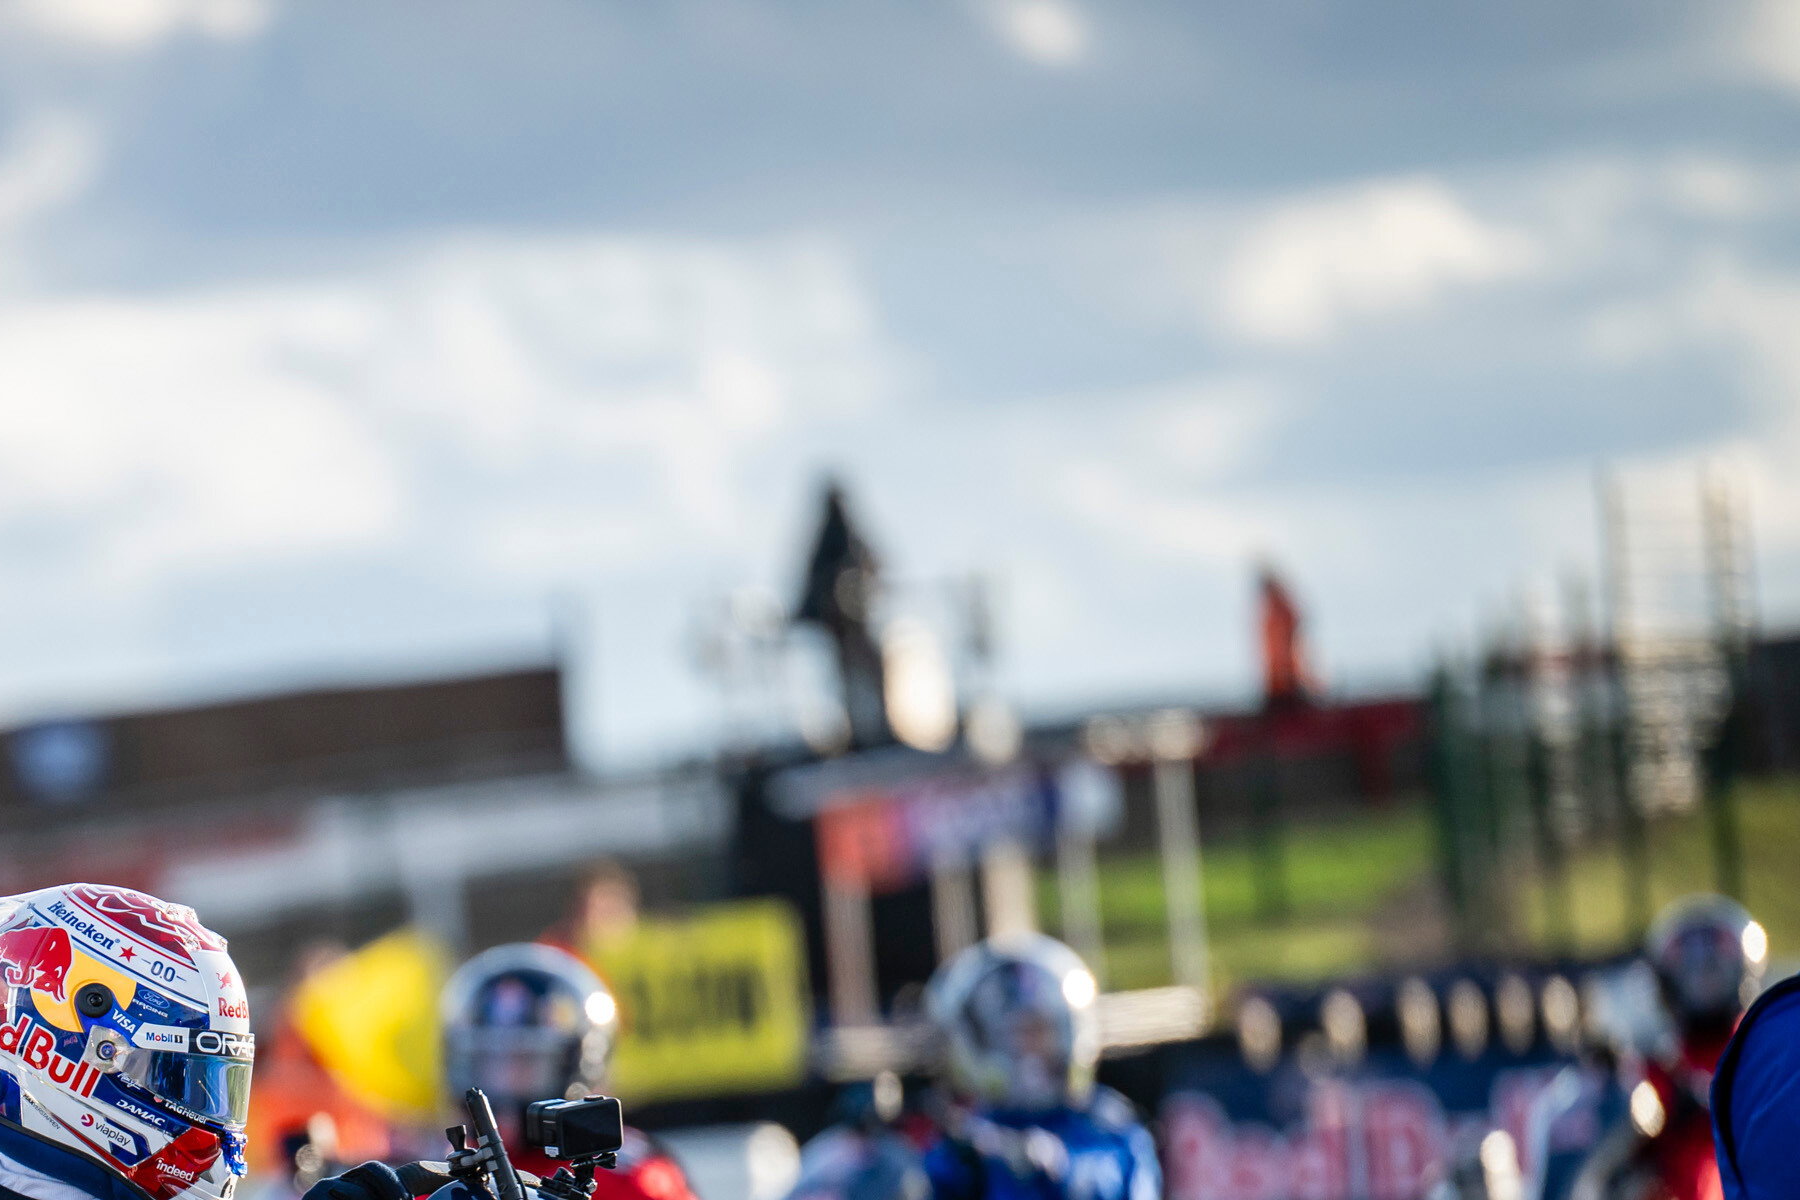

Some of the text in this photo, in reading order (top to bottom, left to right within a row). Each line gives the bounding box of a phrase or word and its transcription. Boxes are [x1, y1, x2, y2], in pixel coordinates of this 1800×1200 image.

[47, 901, 117, 950] Heineken
[112, 1009, 136, 1034] VISA
[146, 1032, 173, 1043] Mobil
[116, 1099, 166, 1126] DAMAC
[95, 1121, 131, 1147] viaplay
[156, 1160, 195, 1182] indeed
